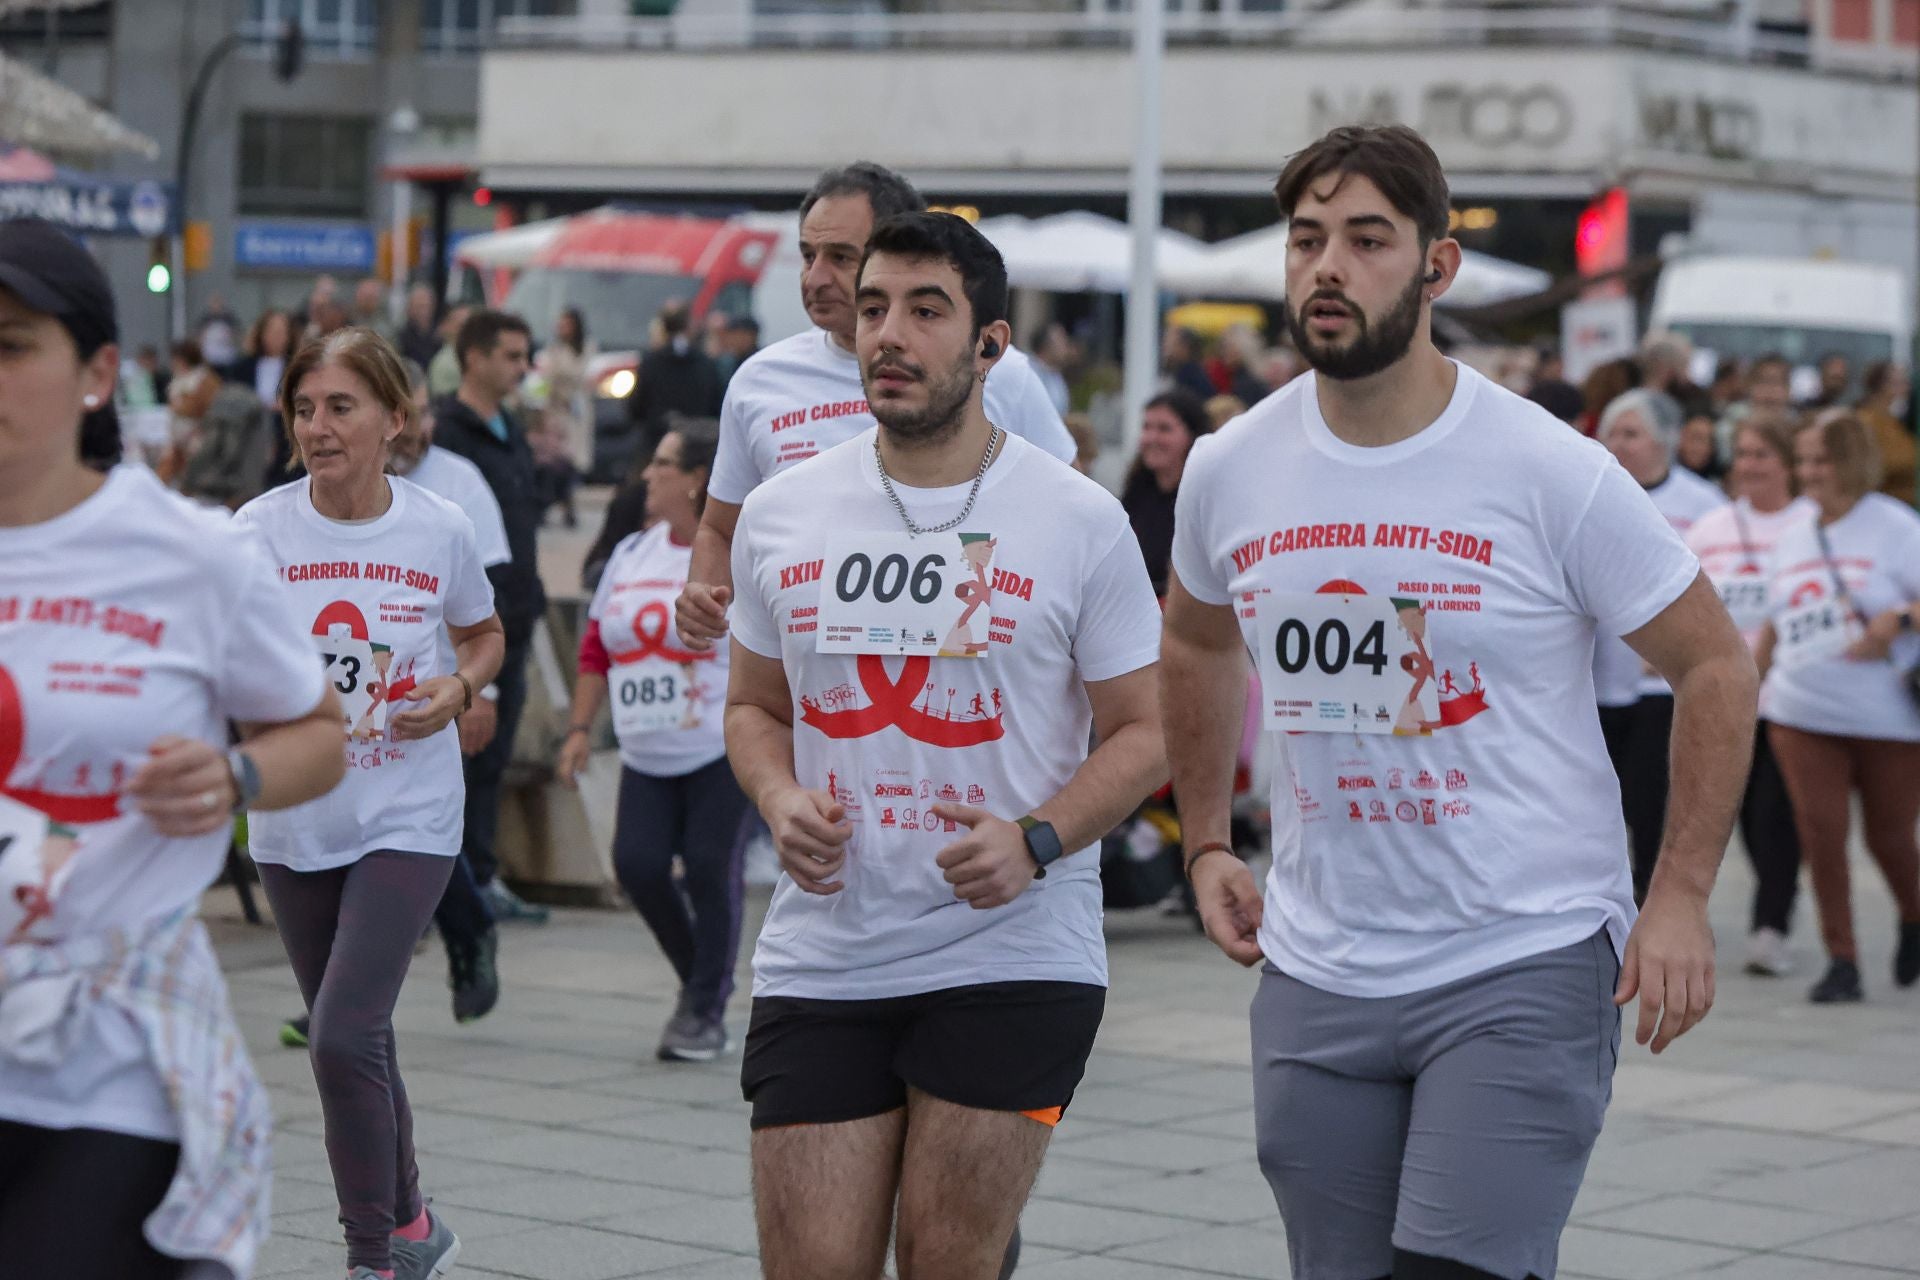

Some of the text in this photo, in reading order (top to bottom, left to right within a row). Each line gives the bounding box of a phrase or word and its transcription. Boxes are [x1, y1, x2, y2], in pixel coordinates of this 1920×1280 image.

[771, 408, 806, 433] XXIV
[1231, 523, 1493, 574] XXIV CARRERA ANTI-SIDA
[287, 561, 360, 582] CARRERA
[363, 562, 439, 595] ANTI-SIDA
[780, 559, 824, 590] XXIV
[836, 552, 947, 604] 006
[1397, 582, 1481, 595] PASEO DEL MURO
[1438, 600, 1481, 612] LORENZO
[990, 616, 1017, 630] MURO
[1274, 617, 1389, 677] 004
[620, 675, 675, 707] 083
